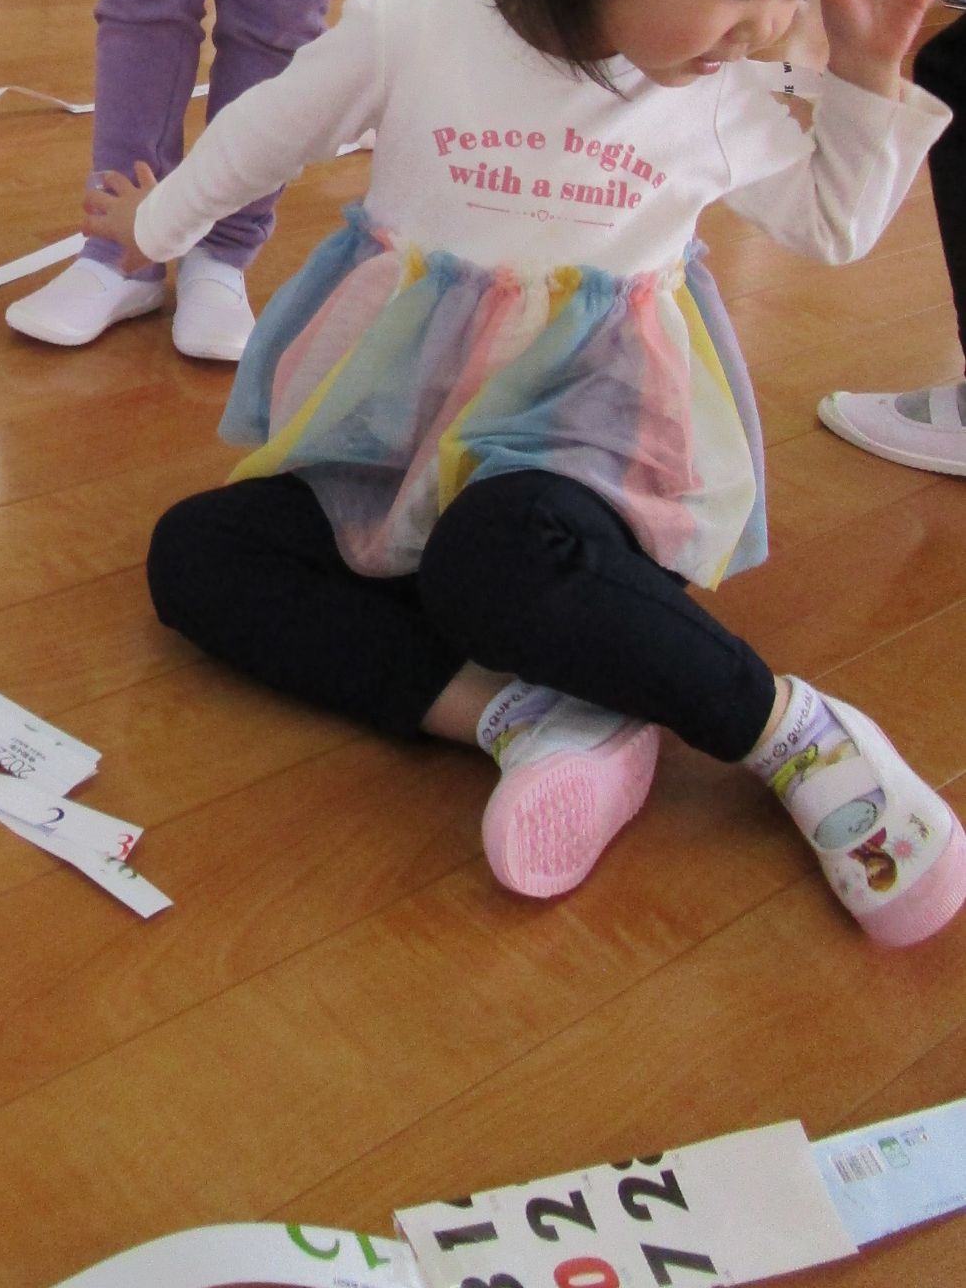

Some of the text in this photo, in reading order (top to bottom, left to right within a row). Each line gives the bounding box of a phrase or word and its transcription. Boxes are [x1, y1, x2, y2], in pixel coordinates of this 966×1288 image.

[432, 126, 667, 189] Peace begins
[449, 162, 642, 209] with a smile
[35, 806, 65, 835] 2
